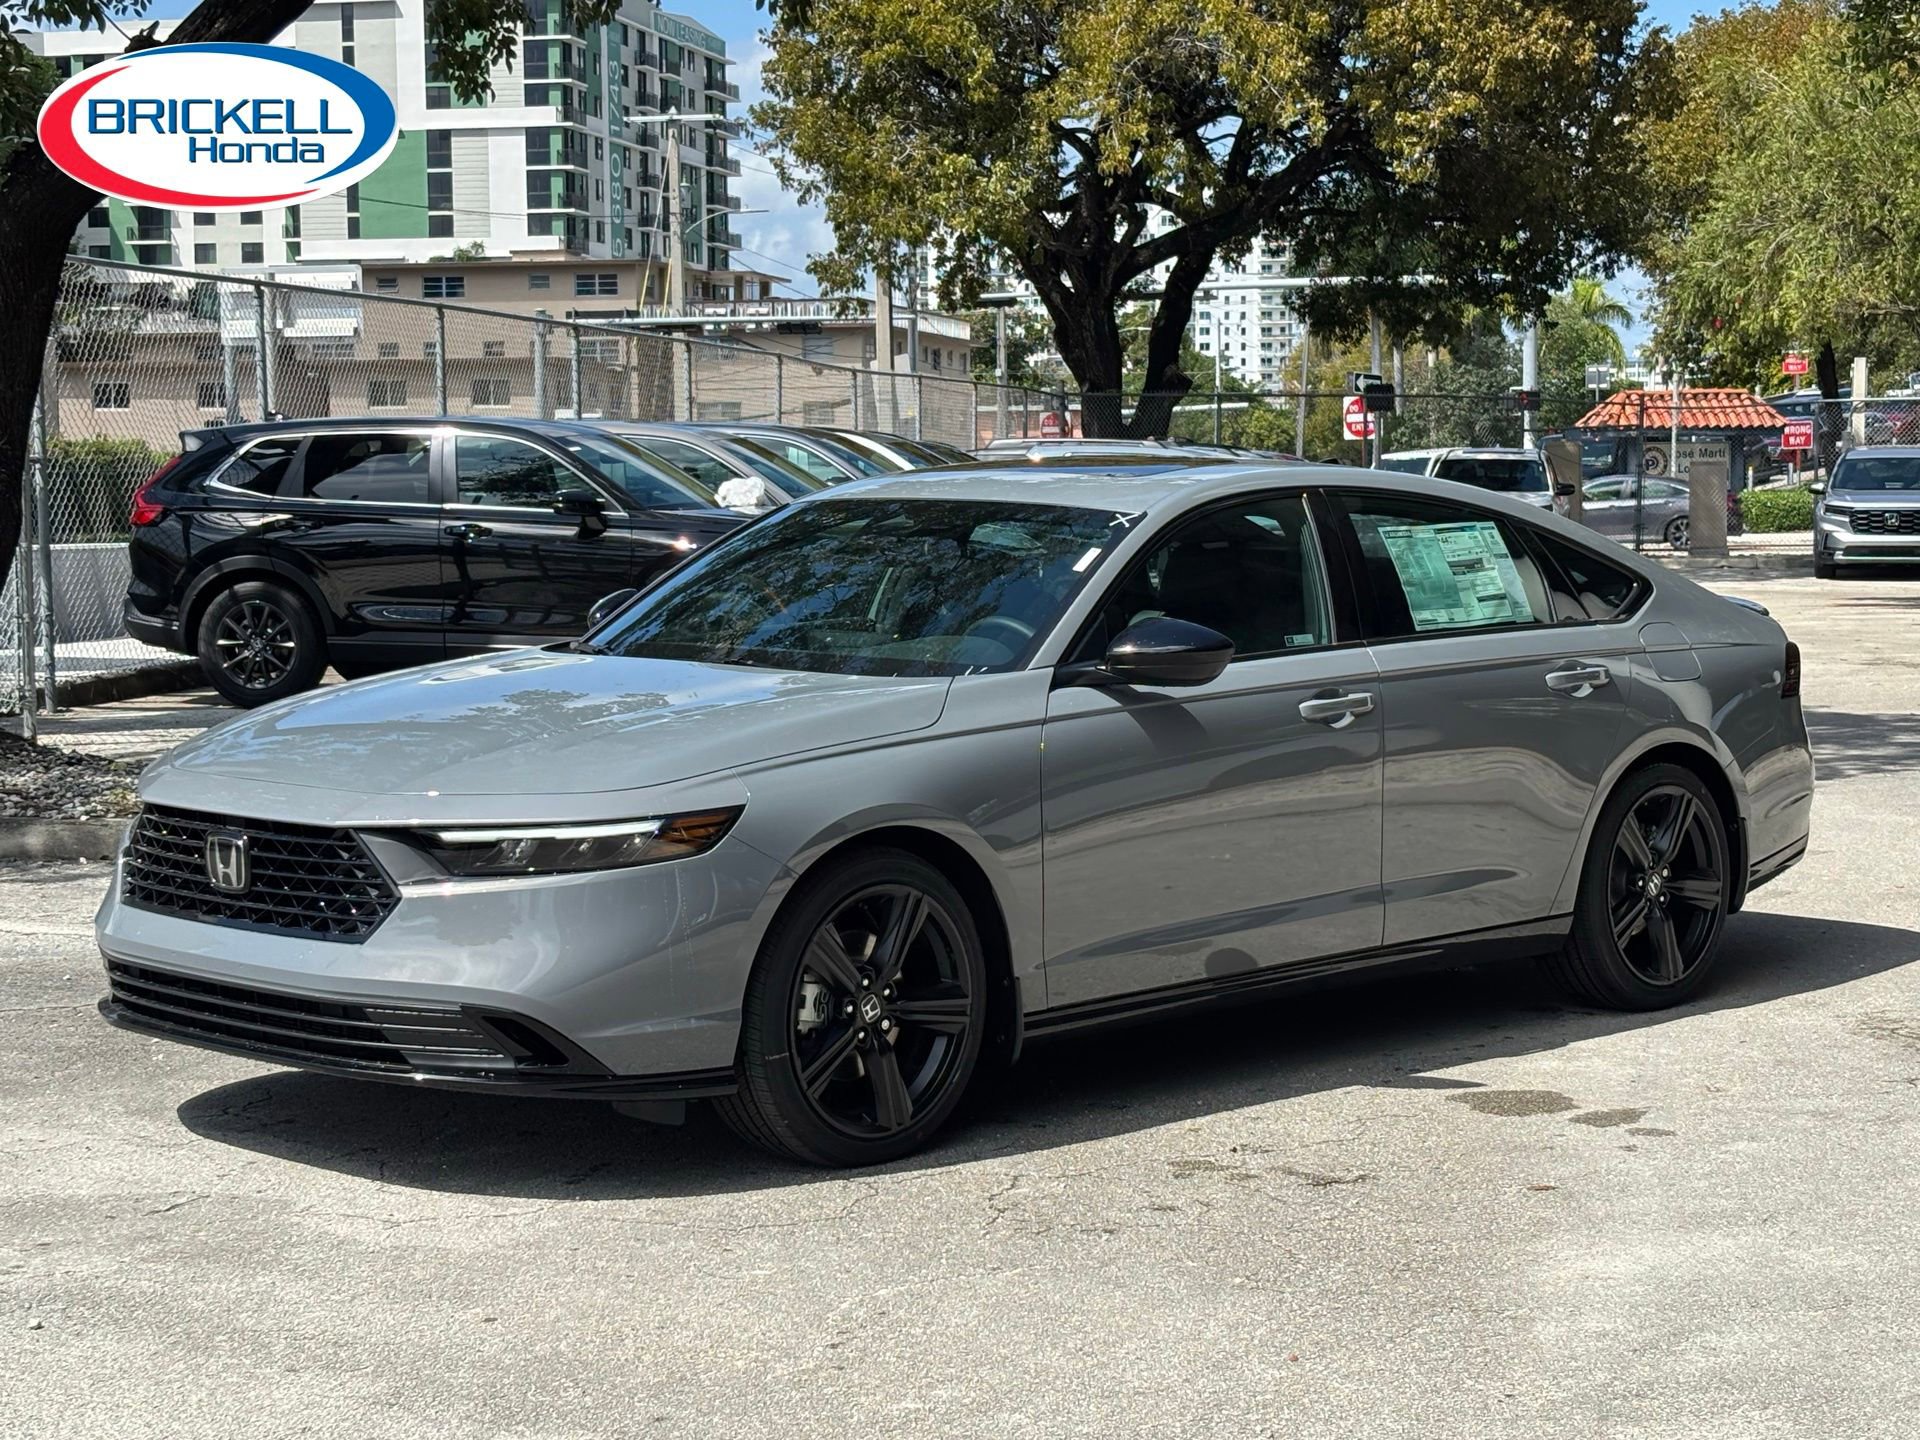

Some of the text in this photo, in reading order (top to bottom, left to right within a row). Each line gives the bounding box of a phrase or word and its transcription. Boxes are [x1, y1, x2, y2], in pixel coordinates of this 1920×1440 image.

[658, 14, 675, 37] NOW
[676, 20, 706, 50] LEASING
[608, 60, 620, 134] 1743
[610, 153, 622, 223] 680
[1669, 447, 1694, 459] osé
[1788, 435, 1806, 445] WAY
